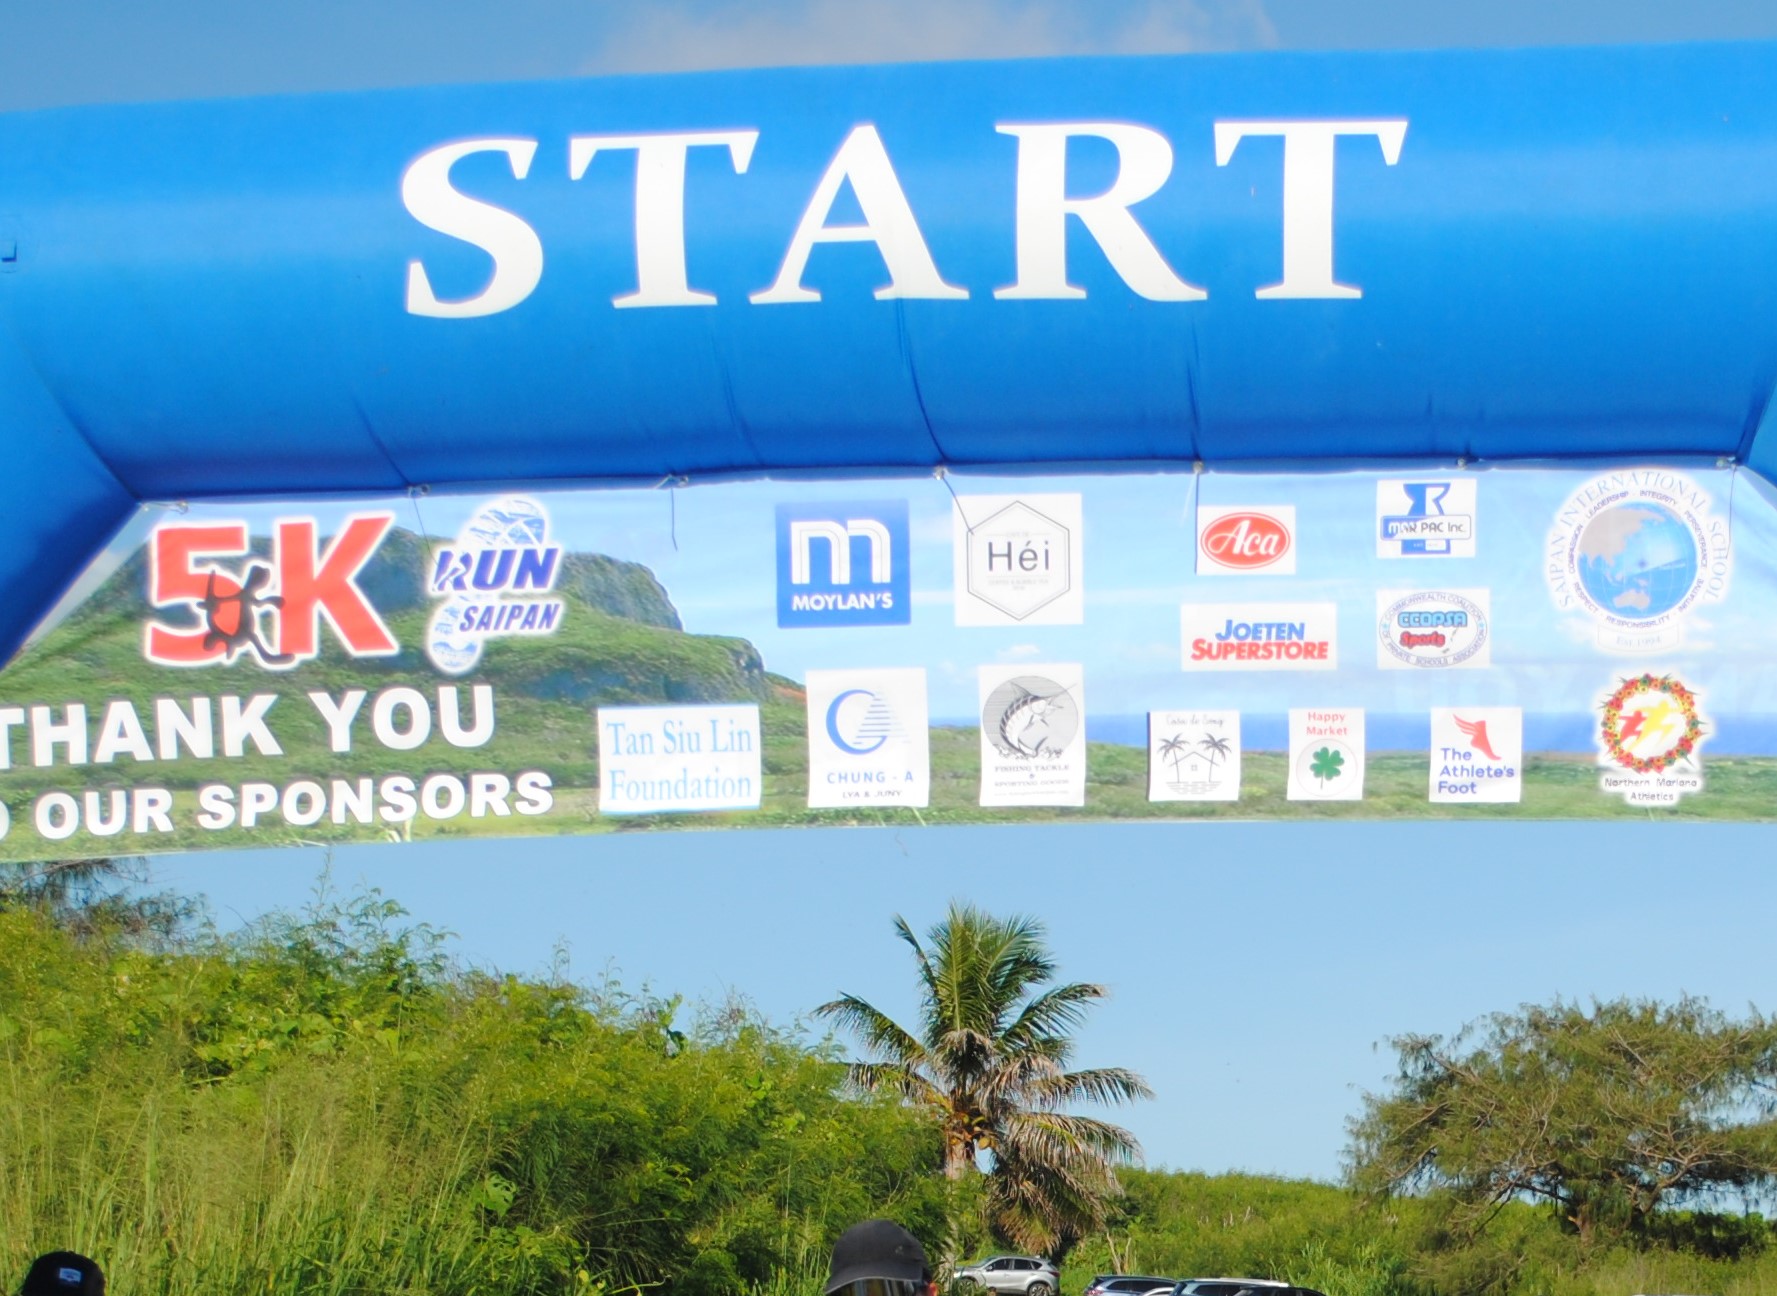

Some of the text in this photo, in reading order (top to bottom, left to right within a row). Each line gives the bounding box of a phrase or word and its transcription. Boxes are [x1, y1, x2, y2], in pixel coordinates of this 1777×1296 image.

[402, 121, 1408, 318] START
[1208, 520, 1280, 556] Aca
[1421, 522, 1444, 533] PAC
[1550, 470, 1728, 608] SAIPAN INTERNATIONAL SCHOOL
[988, 540, 1050, 572] Héi
[1568, 490, 1708, 628] LEADERSHIP INTEGRITY PERSEVERANCE INITIATIVE RESPONSIBILITY RESPECT COMPASSION
[433, 548, 559, 591] RUN
[150, 515, 397, 663] 5K
[792, 593, 893, 611] MOYLAN'S
[1385, 591, 1482, 621] COMMONWEALTH COALITION
[459, 603, 561, 632] SAIPAN
[1398, 611, 1468, 628] CCOPSA
[1215, 619, 1305, 641] JOETEN
[1191, 638, 1328, 661] SUPERSTORE
[308, 685, 494, 752] YOU
[1307, 712, 1345, 725] Happy
[606, 719, 752, 756] Tan Siu Lin
[1306, 726, 1347, 736] Market
[1441, 748, 1472, 761] The
[827, 771, 886, 784] CHUNG
[904, 771, 914, 783] A
[1034, 764, 1070, 772] TACKLE
[1440, 765, 1515, 778] Athlete's
[609, 766, 752, 800] Foundation
[1438, 781, 1477, 795] Foot
[1604, 778, 1650, 788] Northern
[35, 787, 174, 839] OUR
[197, 771, 554, 830] SPONSORS
[1630, 792, 1674, 801] Athletics
